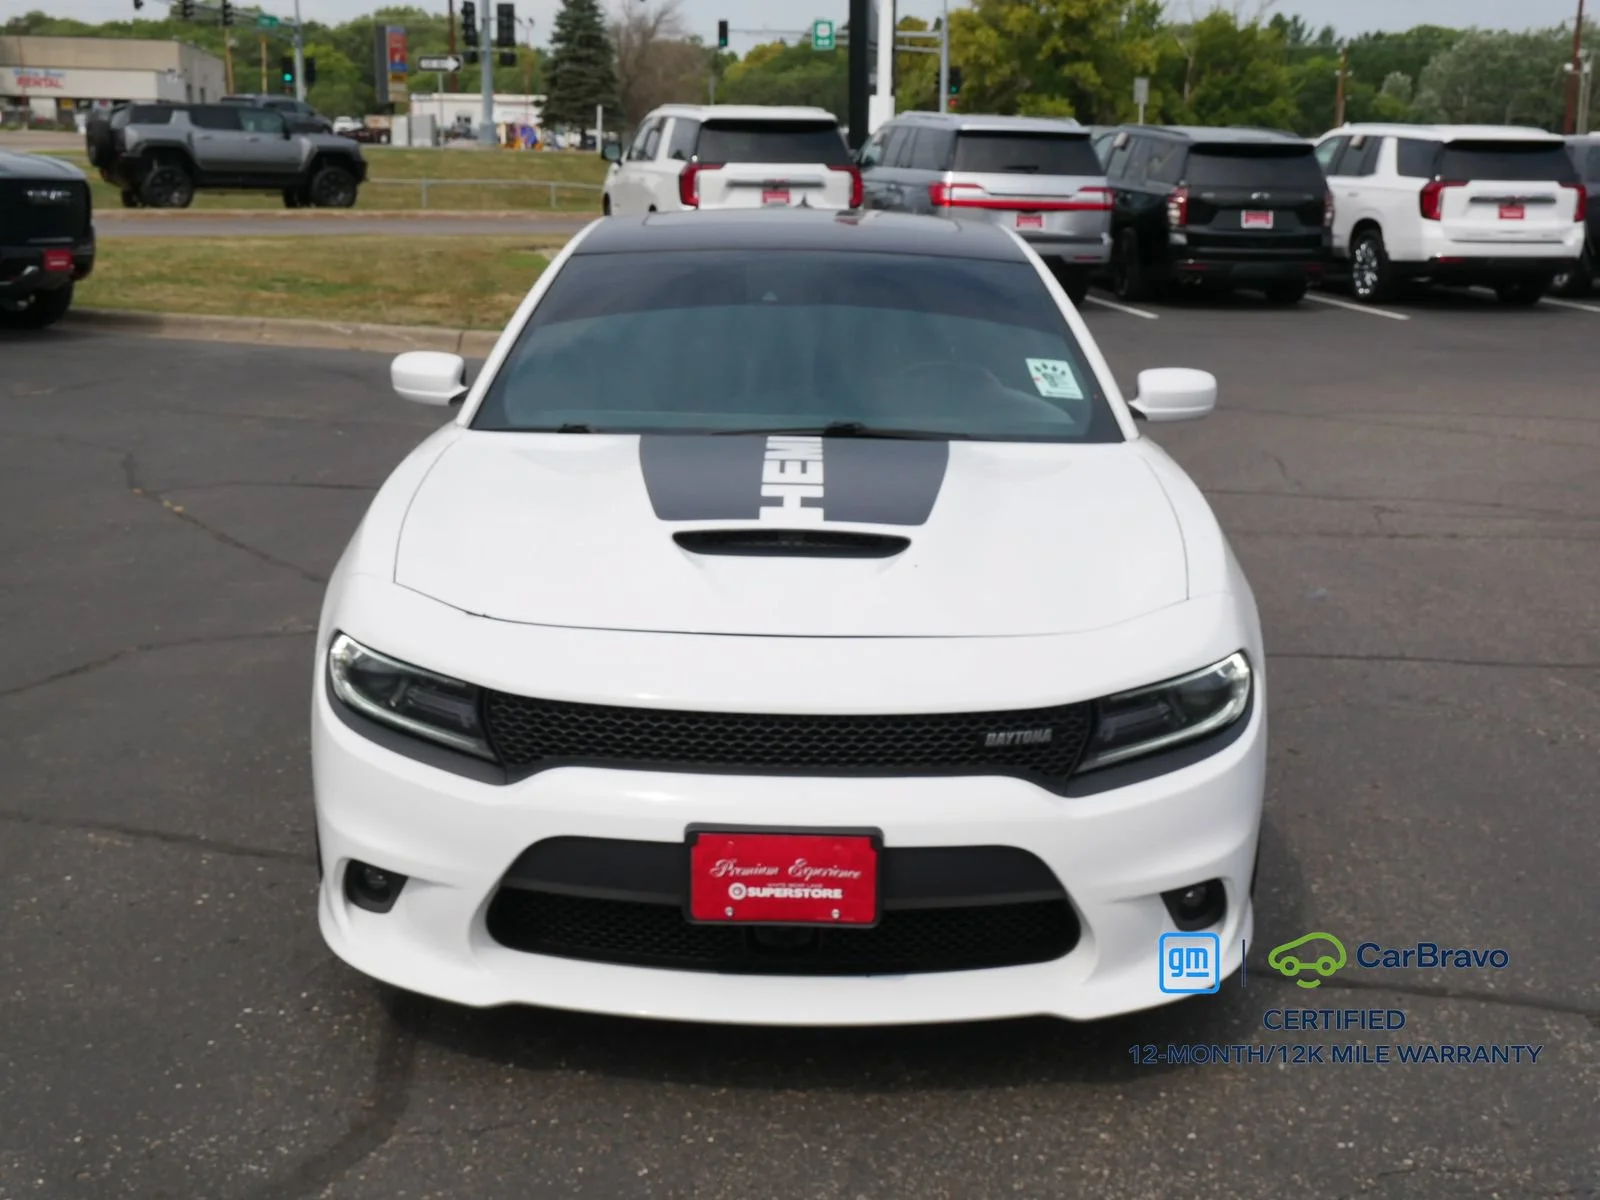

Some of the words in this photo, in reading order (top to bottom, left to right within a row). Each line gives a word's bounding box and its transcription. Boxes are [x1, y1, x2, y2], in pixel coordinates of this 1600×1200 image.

[984, 728, 1052, 747] DAYTONA
[709, 858, 780, 878] Premium
[788, 857, 862, 881] Experience
[747, 886, 843, 899] SUPERSTORE
